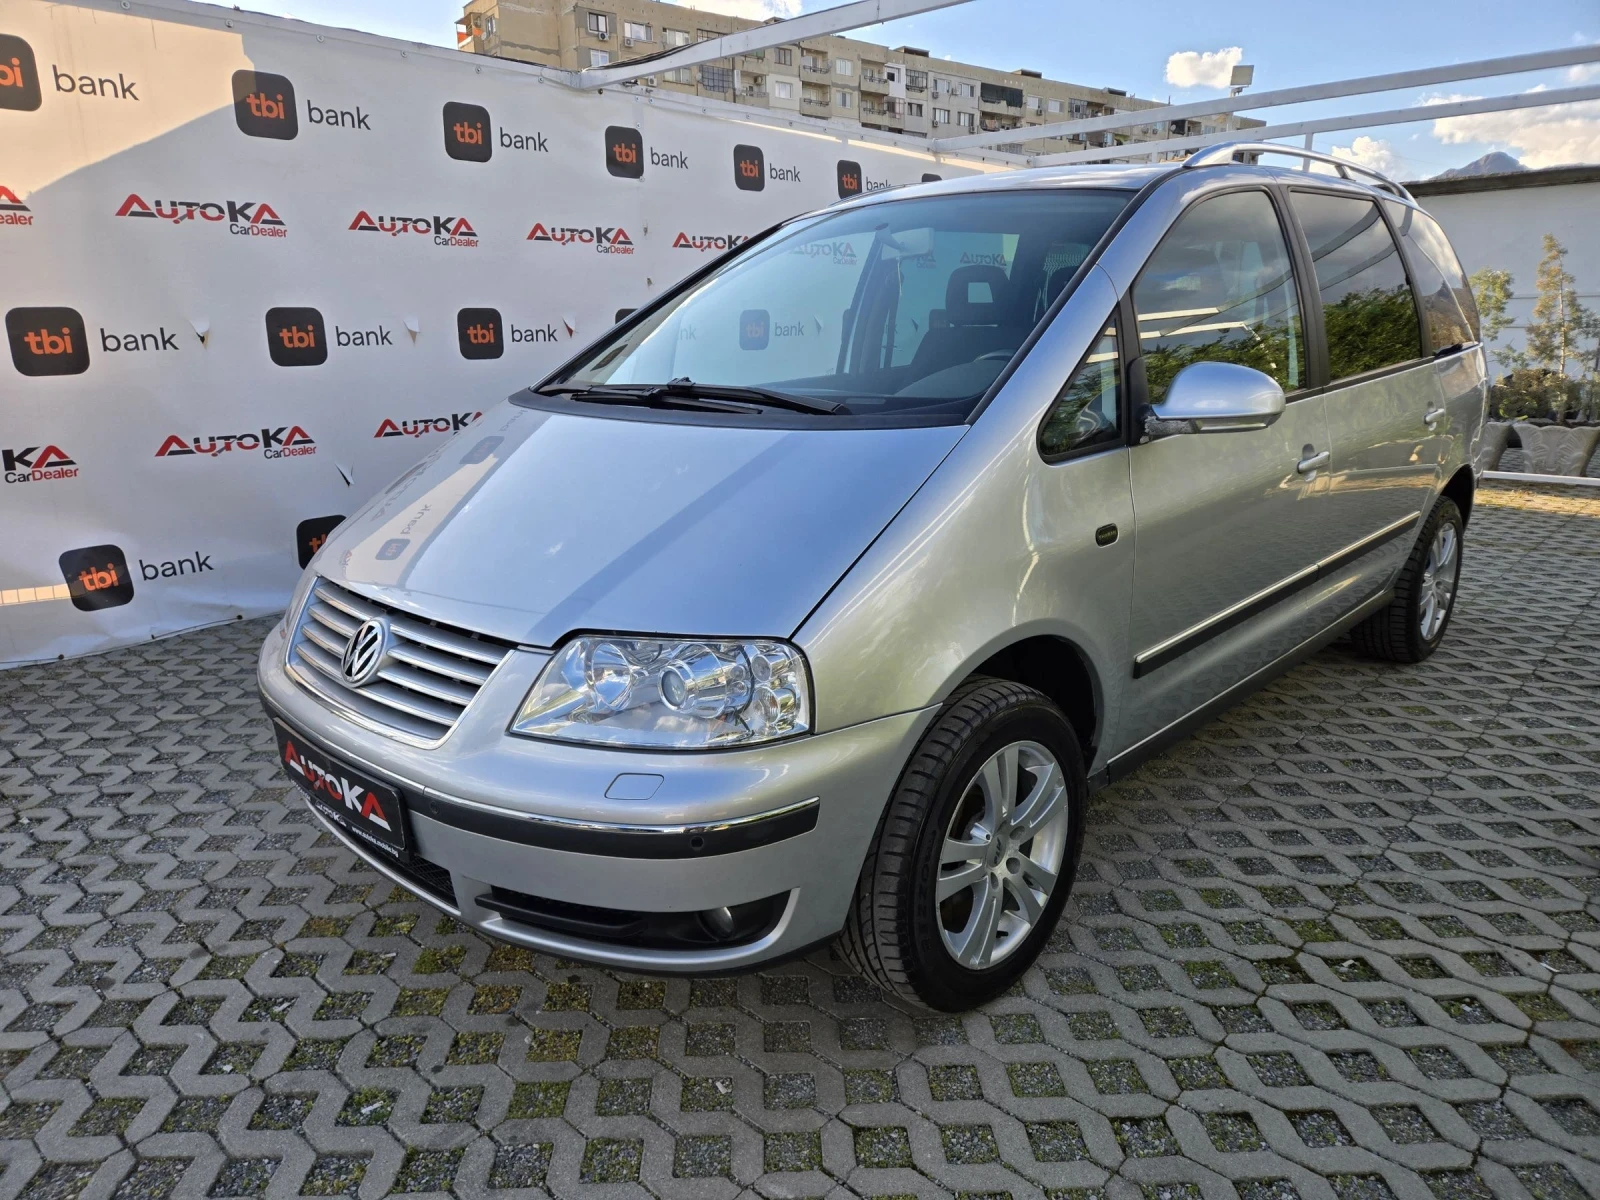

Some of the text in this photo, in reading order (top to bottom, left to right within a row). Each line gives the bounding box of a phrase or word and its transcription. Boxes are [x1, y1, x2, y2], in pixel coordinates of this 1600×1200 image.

[52, 64, 139, 101] bank
[246, 93, 371, 131] tbi bank
[453, 122, 549, 152] tbi bank
[613, 144, 689, 170] tbi bank
[740, 161, 801, 183] tbi bank
[842, 173, 858, 190] tbi
[230, 223, 288, 238] CarDealer
[434, 235, 479, 247] CarDealer
[672, 232, 749, 252] AUTOK
[279, 324, 393, 349] tbi bank
[467, 324, 559, 344] tbi bank
[774, 321, 805, 337] bank
[23, 327, 180, 356] tbi bank
[373, 411, 483, 438] AUTOK
[263, 445, 317, 459] CarDealer
[4, 467, 79, 484] CarDealer
[78, 551, 214, 592] tbi bank
